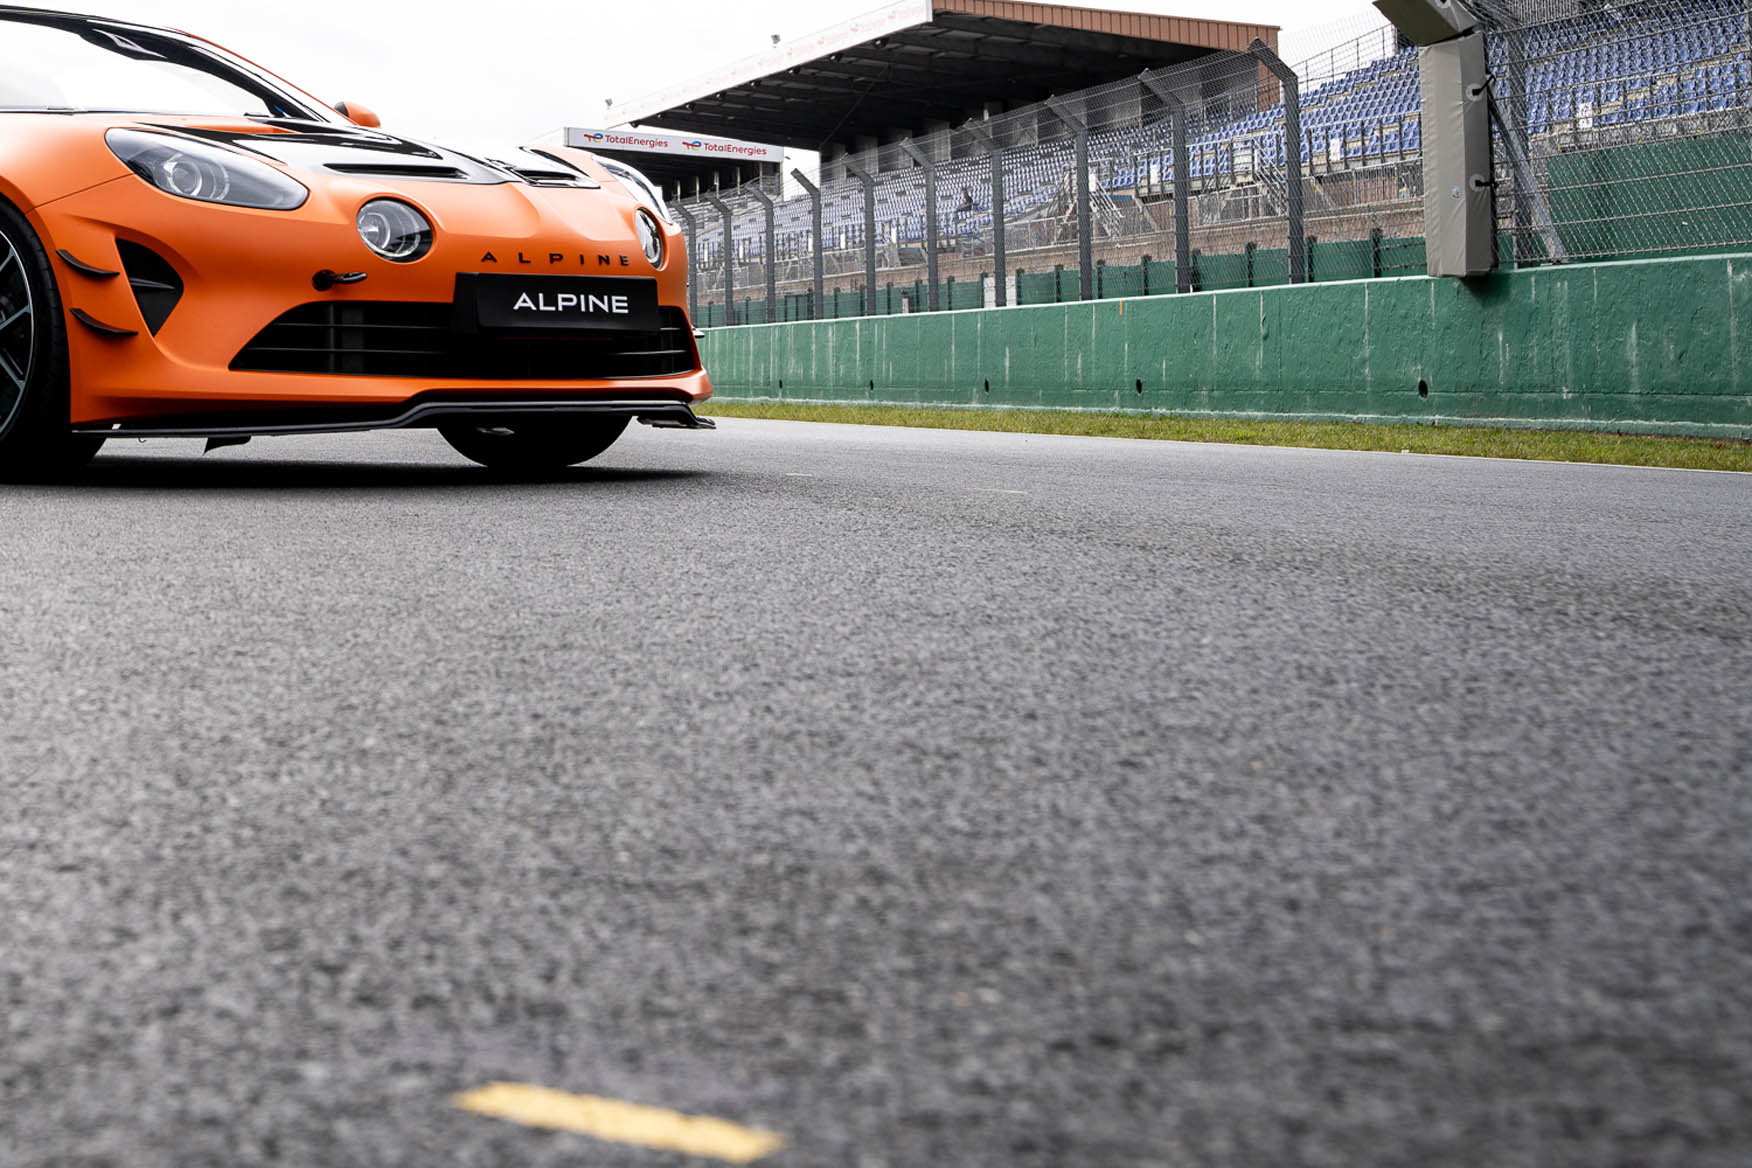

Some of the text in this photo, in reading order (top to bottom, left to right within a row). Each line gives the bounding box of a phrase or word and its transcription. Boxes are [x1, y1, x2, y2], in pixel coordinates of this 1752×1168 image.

[605, 134, 669, 148] TotalEnergies
[703, 142, 768, 157] TotalEnergies
[480, 251, 630, 266] ALPINE
[513, 292, 629, 314] ALPINE
